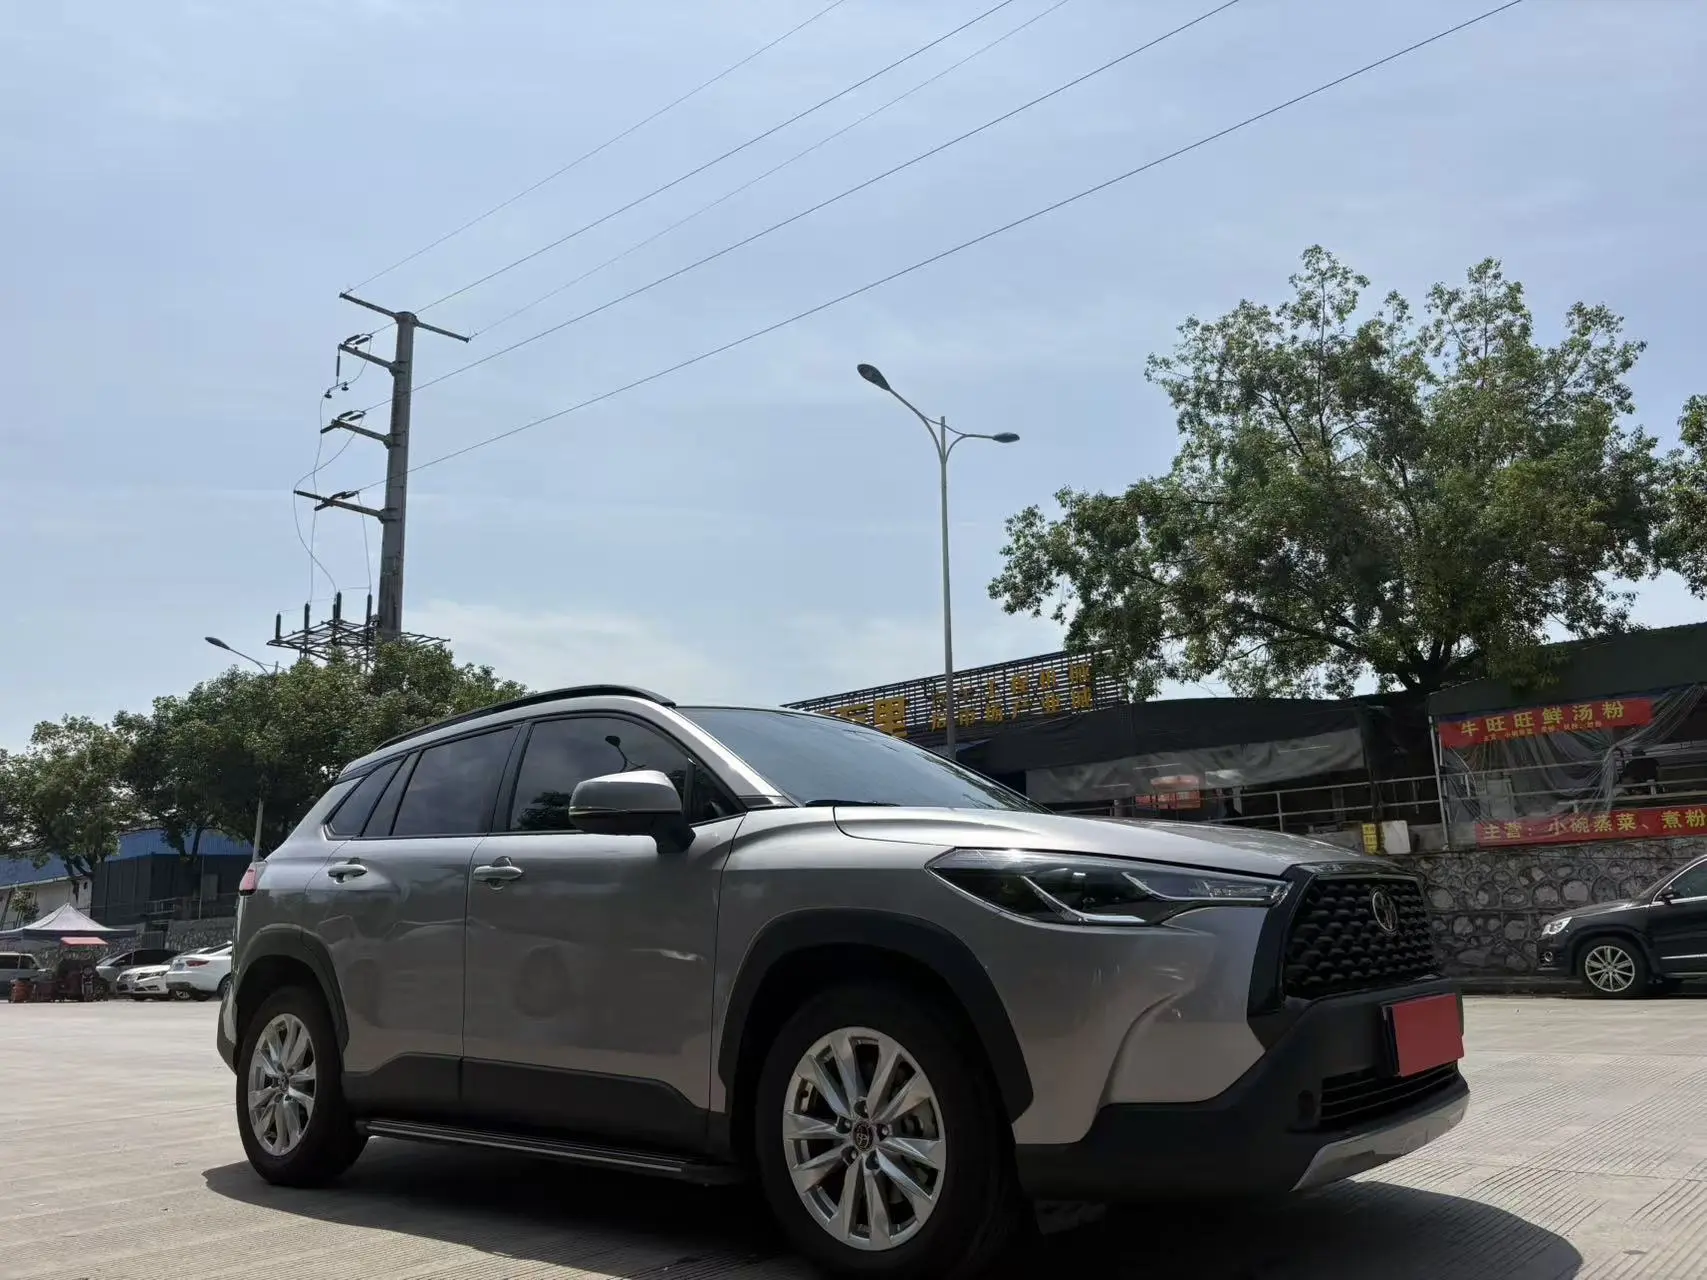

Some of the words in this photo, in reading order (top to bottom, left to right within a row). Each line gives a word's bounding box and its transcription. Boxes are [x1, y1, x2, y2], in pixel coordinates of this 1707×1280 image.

[1461, 700, 1624, 737] 牛旺旺鲜汤粉
